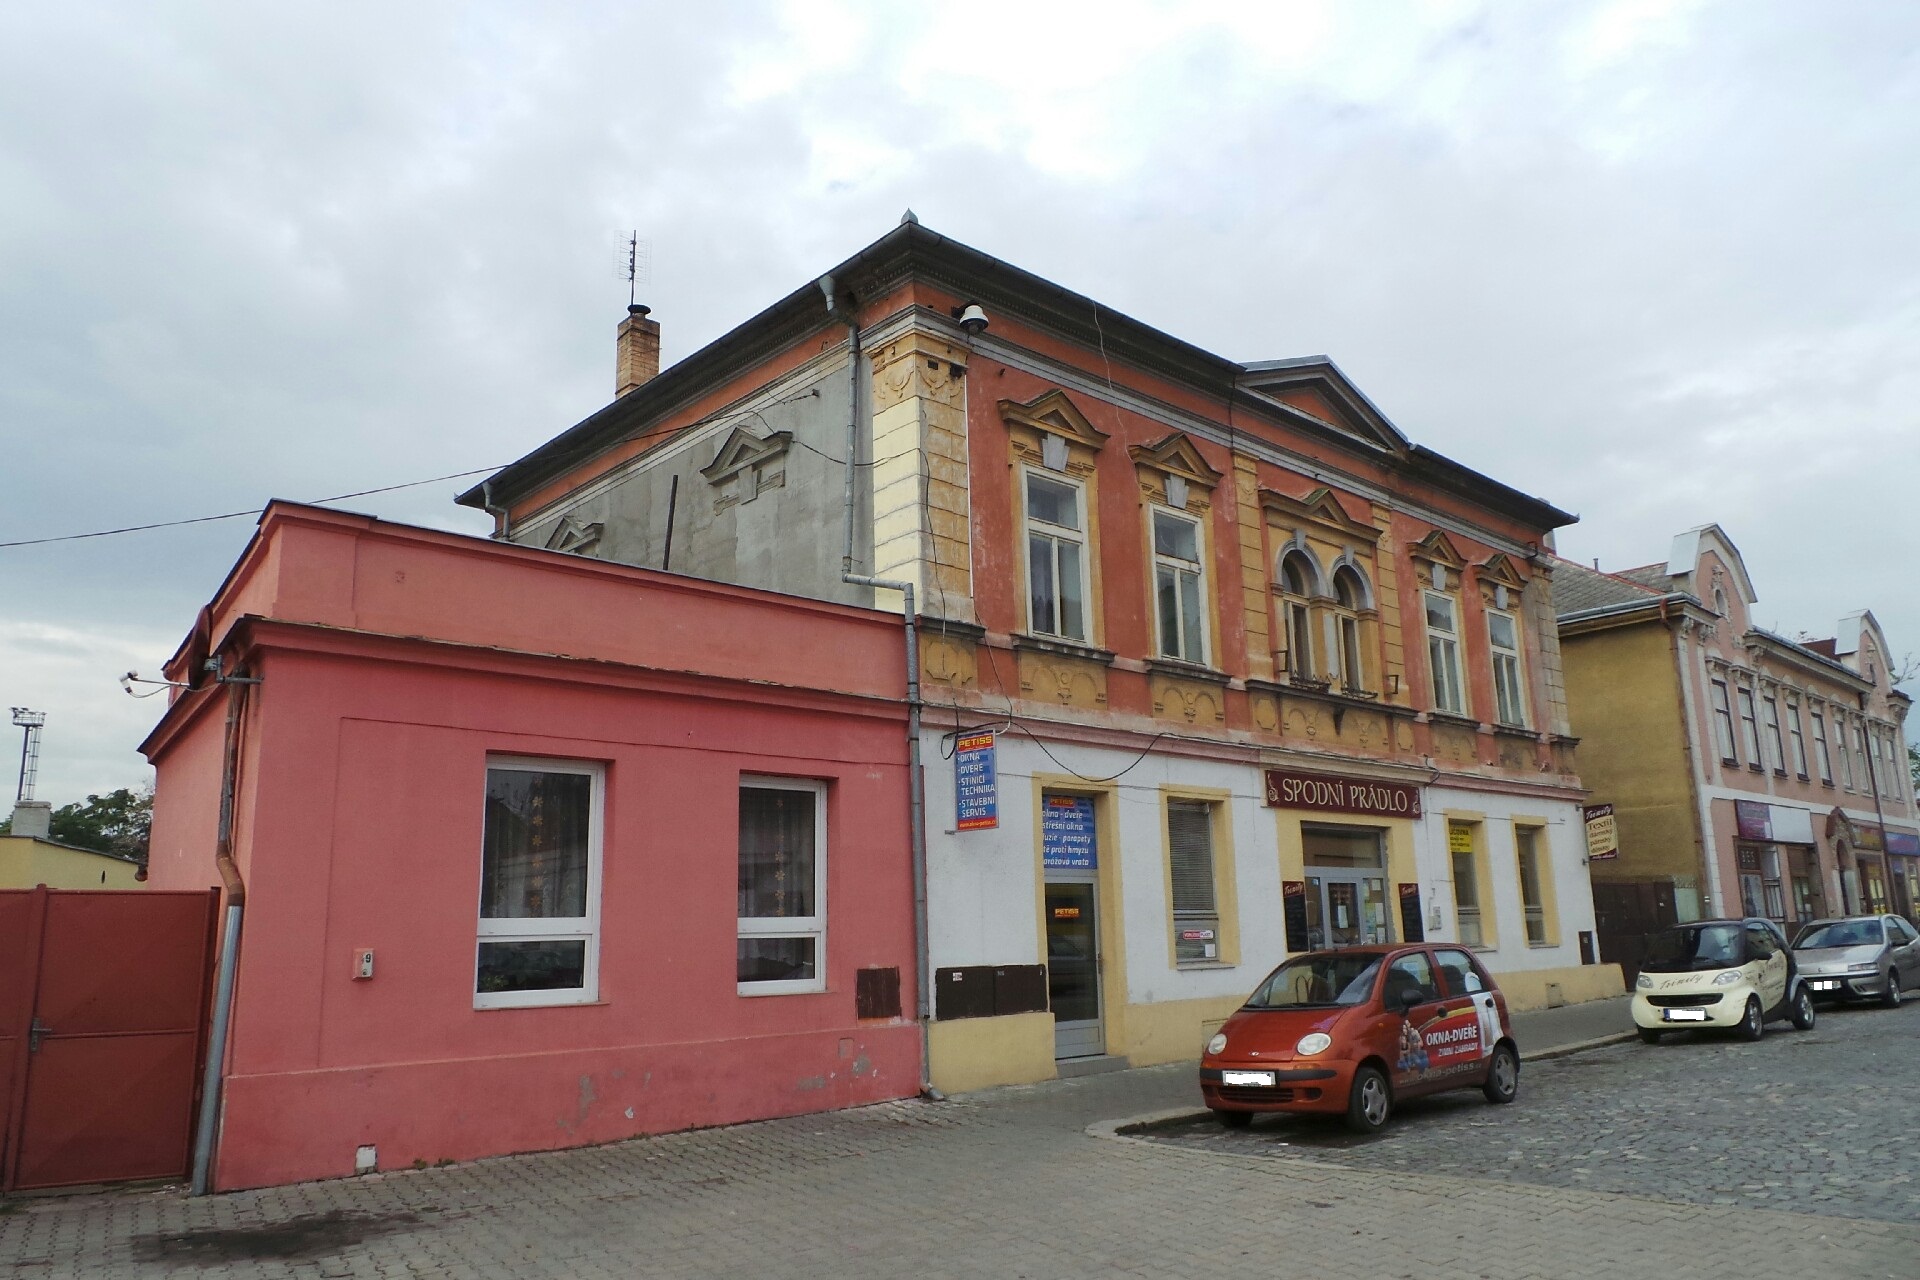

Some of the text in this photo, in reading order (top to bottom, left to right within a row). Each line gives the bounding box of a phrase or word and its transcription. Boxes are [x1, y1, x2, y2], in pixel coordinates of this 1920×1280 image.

[958, 735, 992, 748] PETISS
[960, 752, 980, 763] OKNA
[961, 783, 996, 796] TECHNIKA
[1282, 778, 1408, 812] SPODNÍ PRÁDLO
[961, 807, 986, 818] SERVIS
[1066, 821, 1084, 831] okna
[1589, 818, 1613, 831] Textil
[1062, 834, 1091, 844] parapety
[1050, 845, 1067, 855] proti
[1067, 845, 1089, 856] hmyzu
[1071, 858, 1090, 866] vrata
[1426, 1023, 1478, 1046] OKNA-DVEŘE
